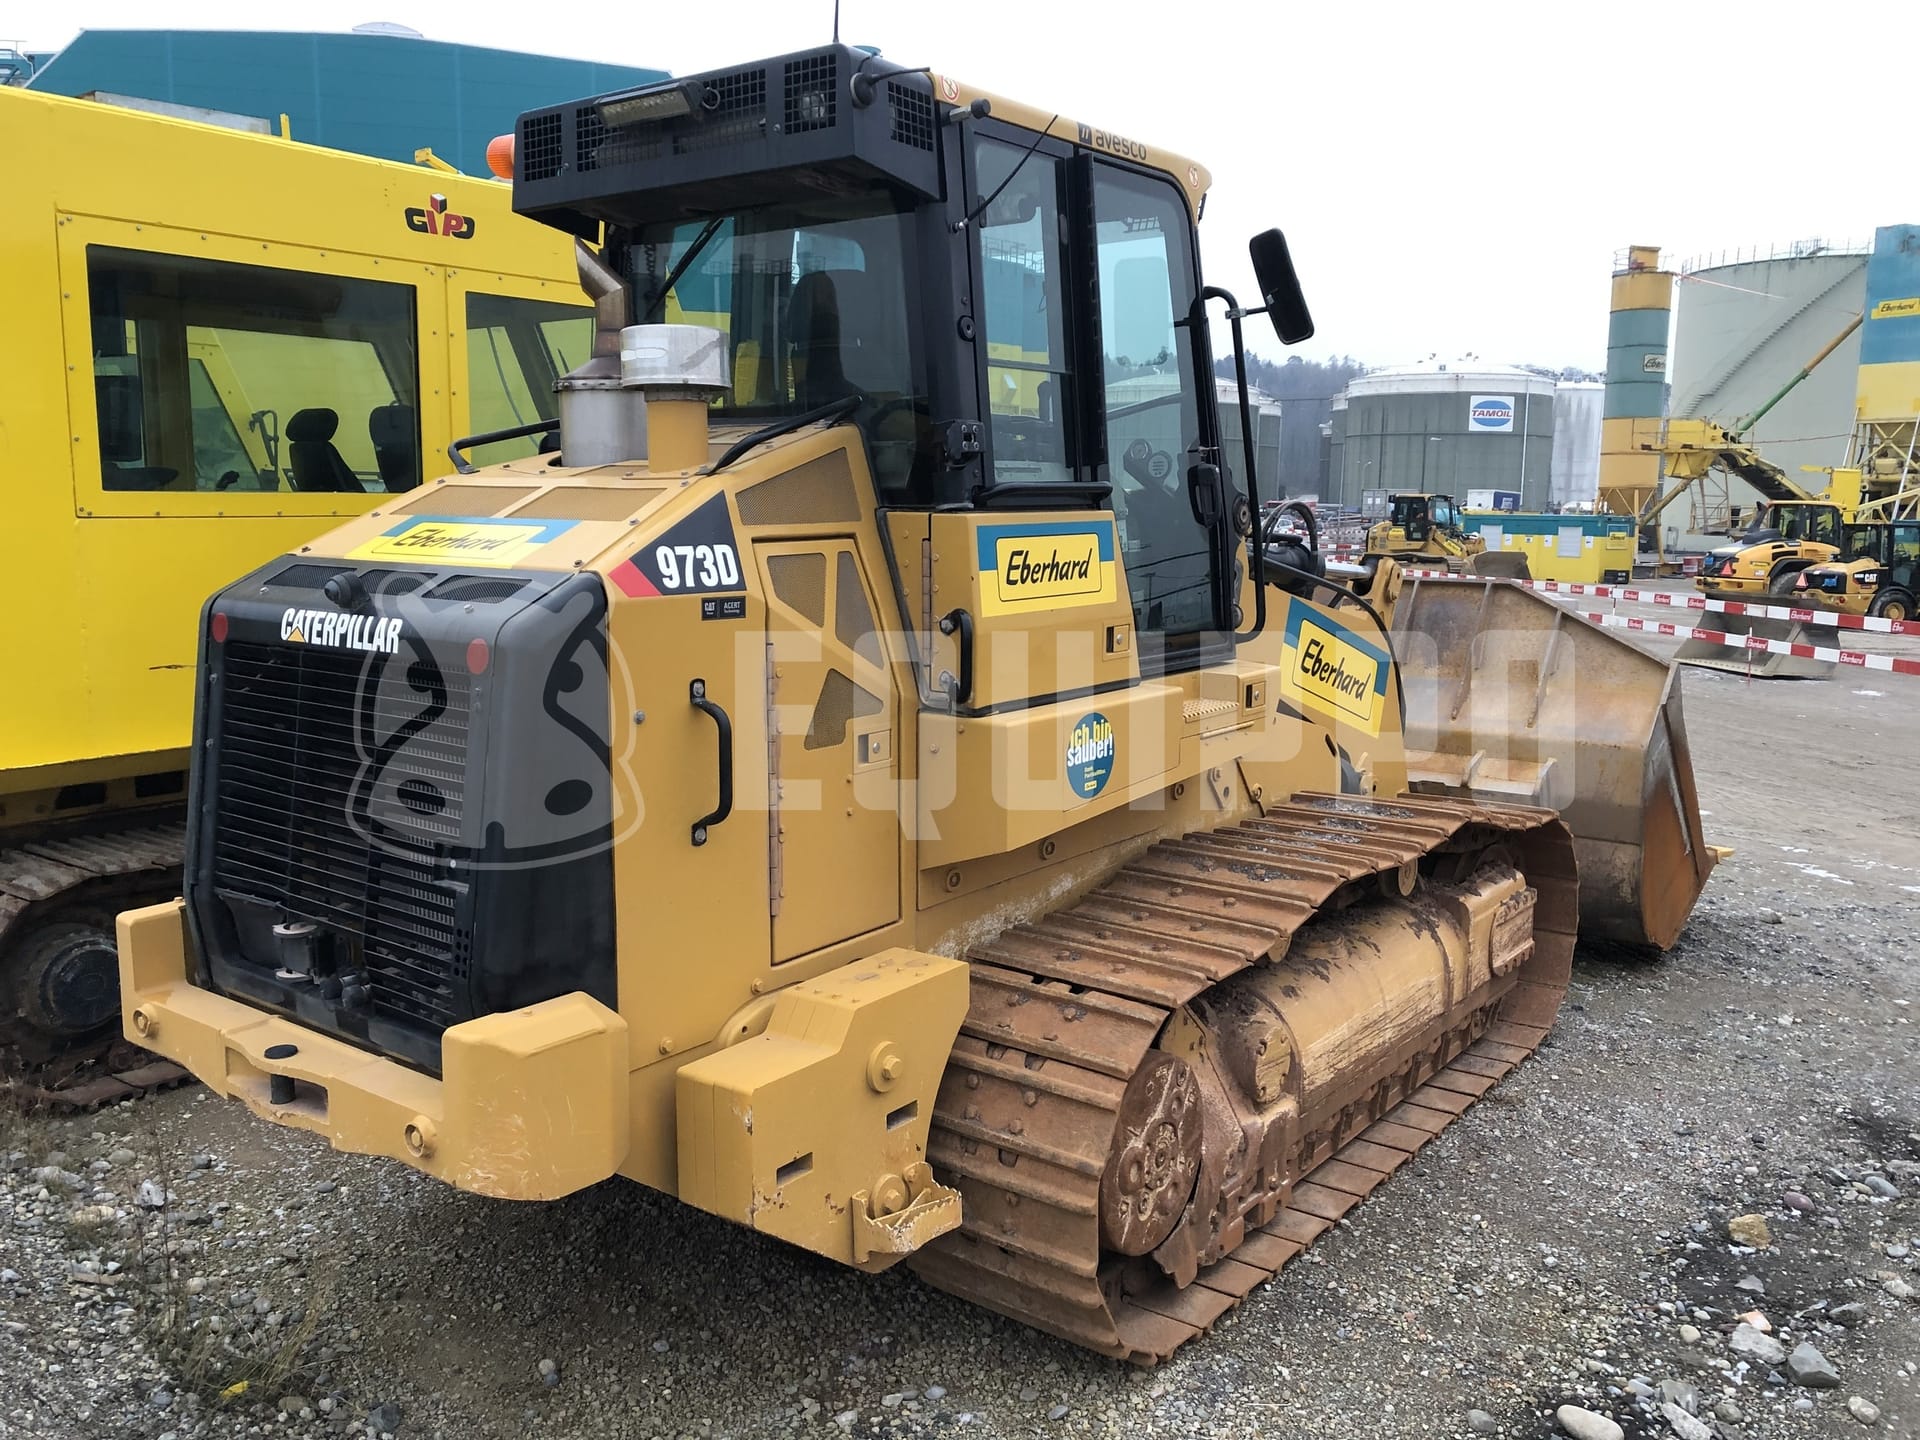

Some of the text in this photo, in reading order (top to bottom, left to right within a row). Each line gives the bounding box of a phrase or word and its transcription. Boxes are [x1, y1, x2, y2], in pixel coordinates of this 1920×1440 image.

[1095, 129, 1147, 161] avesco
[1471, 409, 1513, 418] TAMOIL
[393, 529, 526, 551] Eberhard
[656, 544, 739, 589] 973D
[1006, 548, 1092, 586] Eberhard
[704, 602, 716, 611] CAT
[724, 601, 741, 609] ACERT
[281, 607, 403, 654] CATERPILLAR
[1300, 638, 1372, 702] Eberhard
[1067, 732, 1113, 767] sauber!
